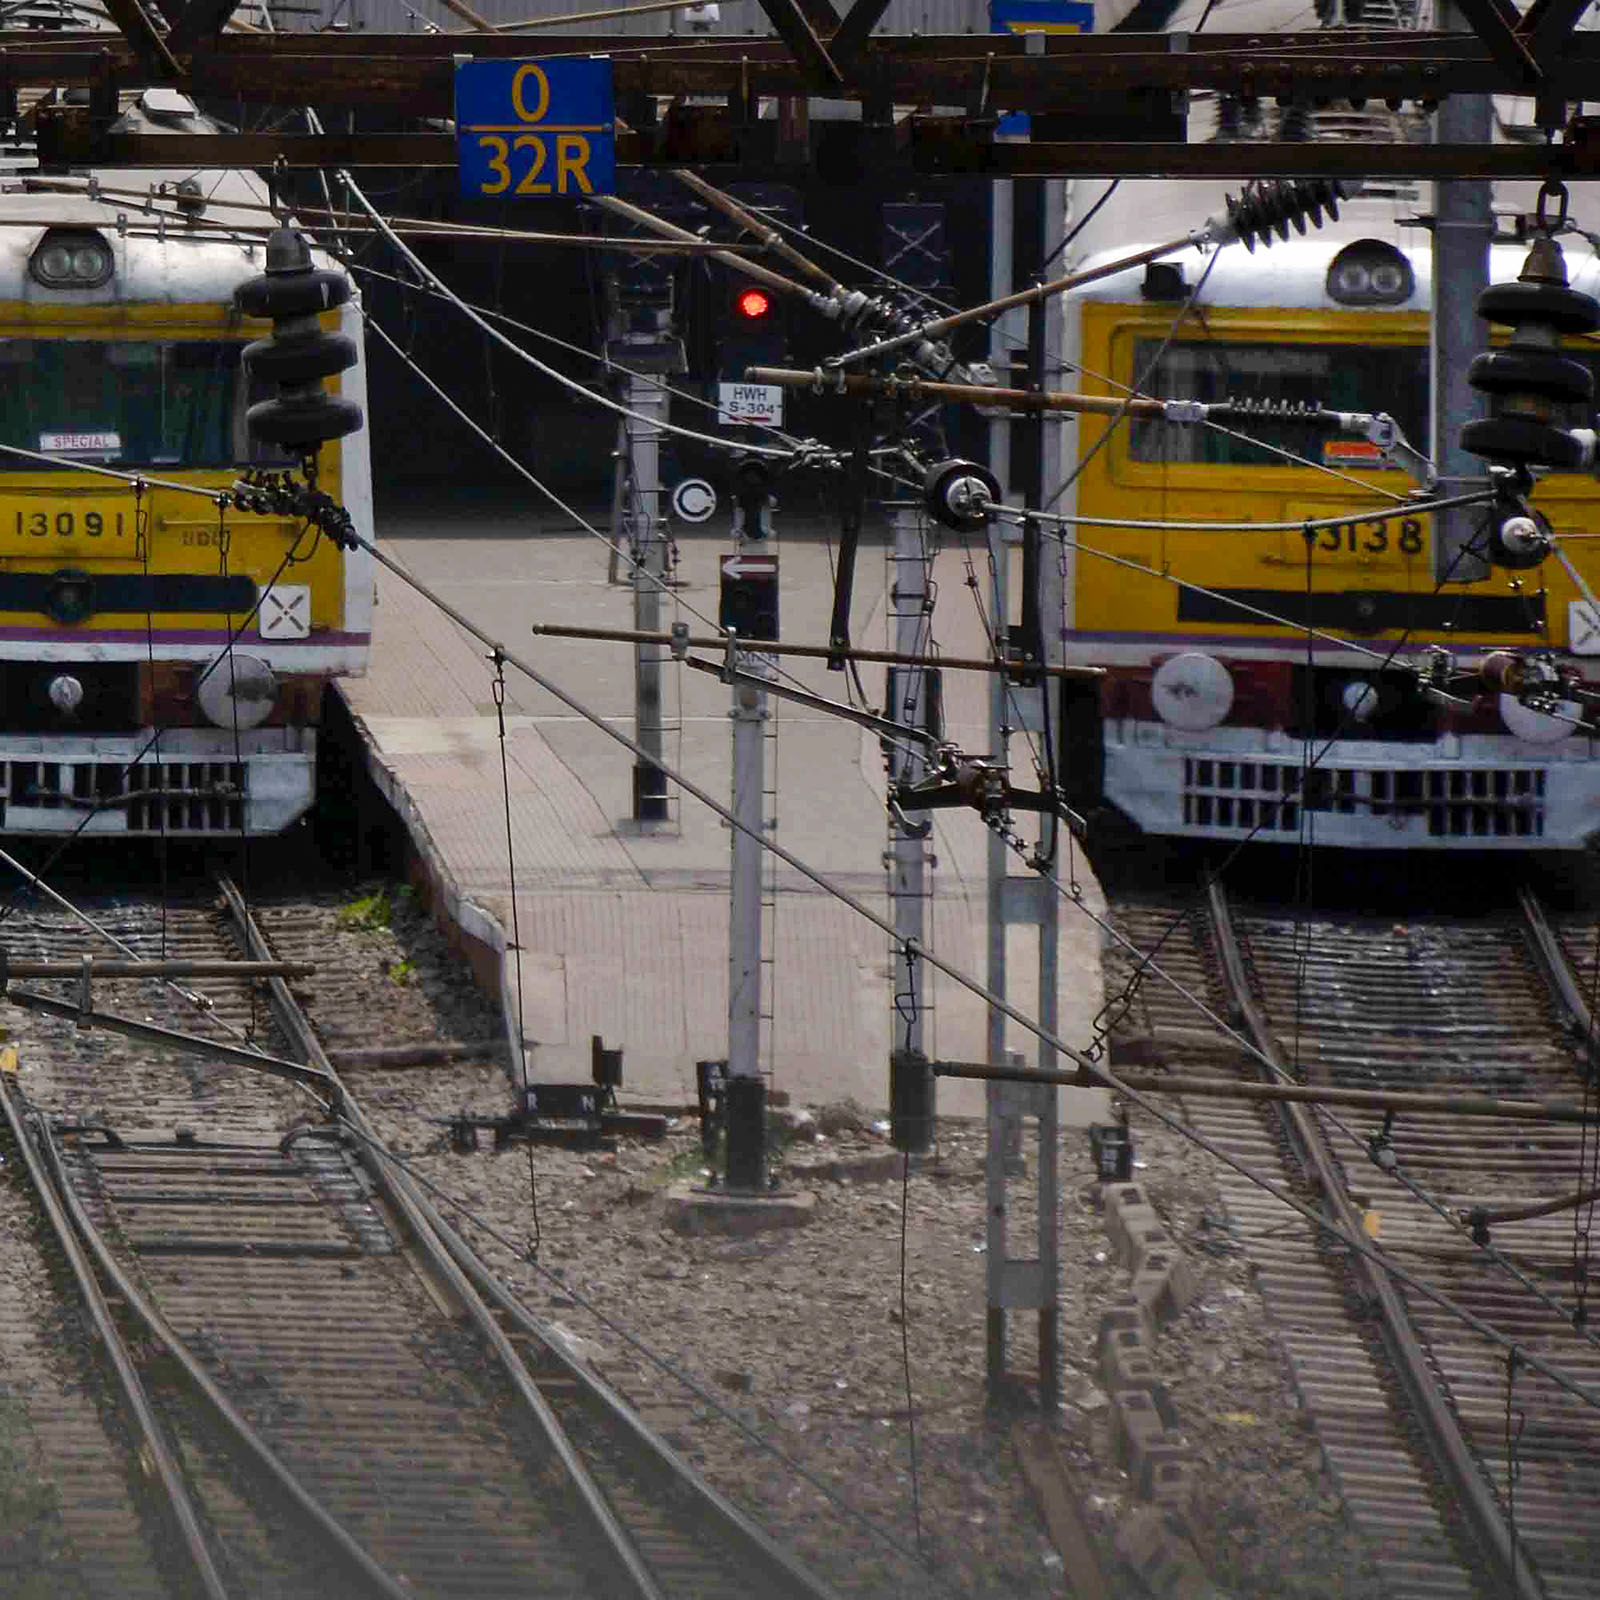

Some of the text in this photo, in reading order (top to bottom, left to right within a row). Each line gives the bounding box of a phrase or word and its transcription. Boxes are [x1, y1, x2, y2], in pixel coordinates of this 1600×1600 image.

[512, 63, 550, 122] 0
[478, 135, 595, 194] 32R
[733, 386, 768, 400] HWH
[729, 402, 775, 414] S-304
[53, 435, 110, 449] SPECIAL
[15, 511, 124, 537] 13091
